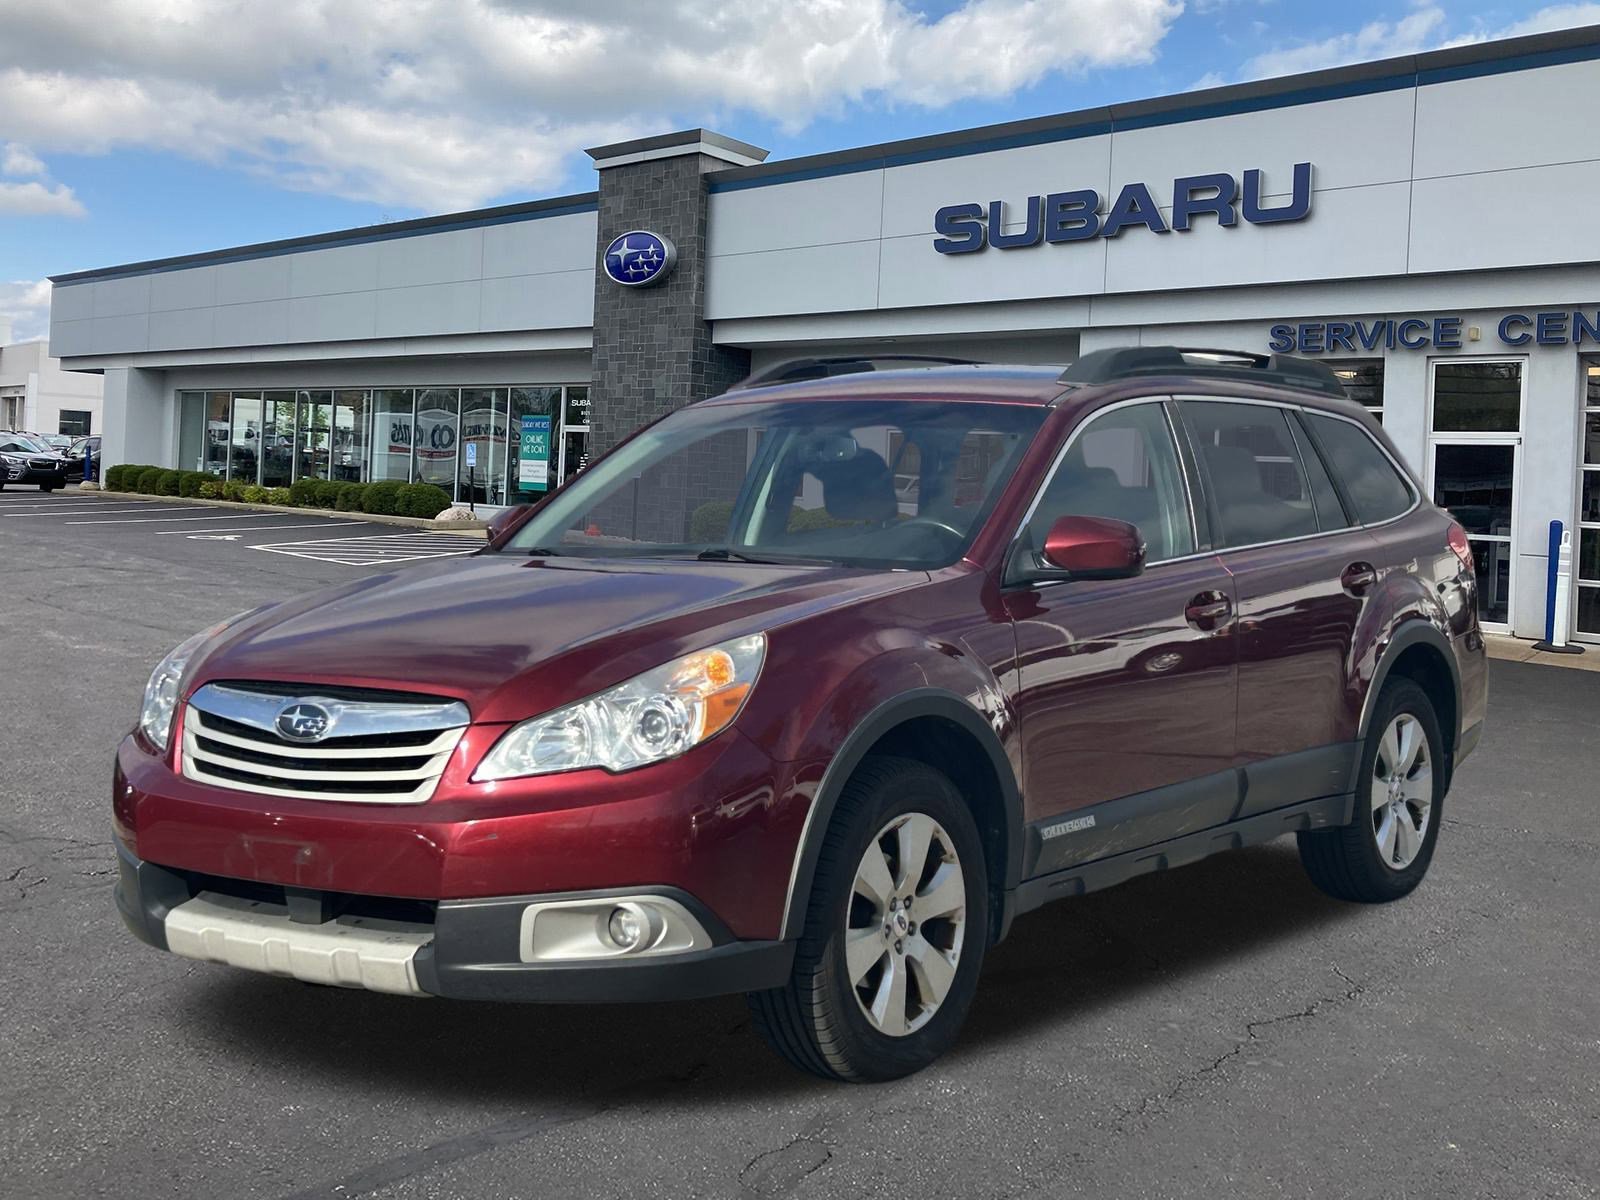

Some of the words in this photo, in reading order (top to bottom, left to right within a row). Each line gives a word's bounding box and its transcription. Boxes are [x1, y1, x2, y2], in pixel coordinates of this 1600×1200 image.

[933, 162, 1313, 254] SUBARU
[1269, 317, 1463, 352] SERVICE
[1497, 311, 1600, 346] CEN
